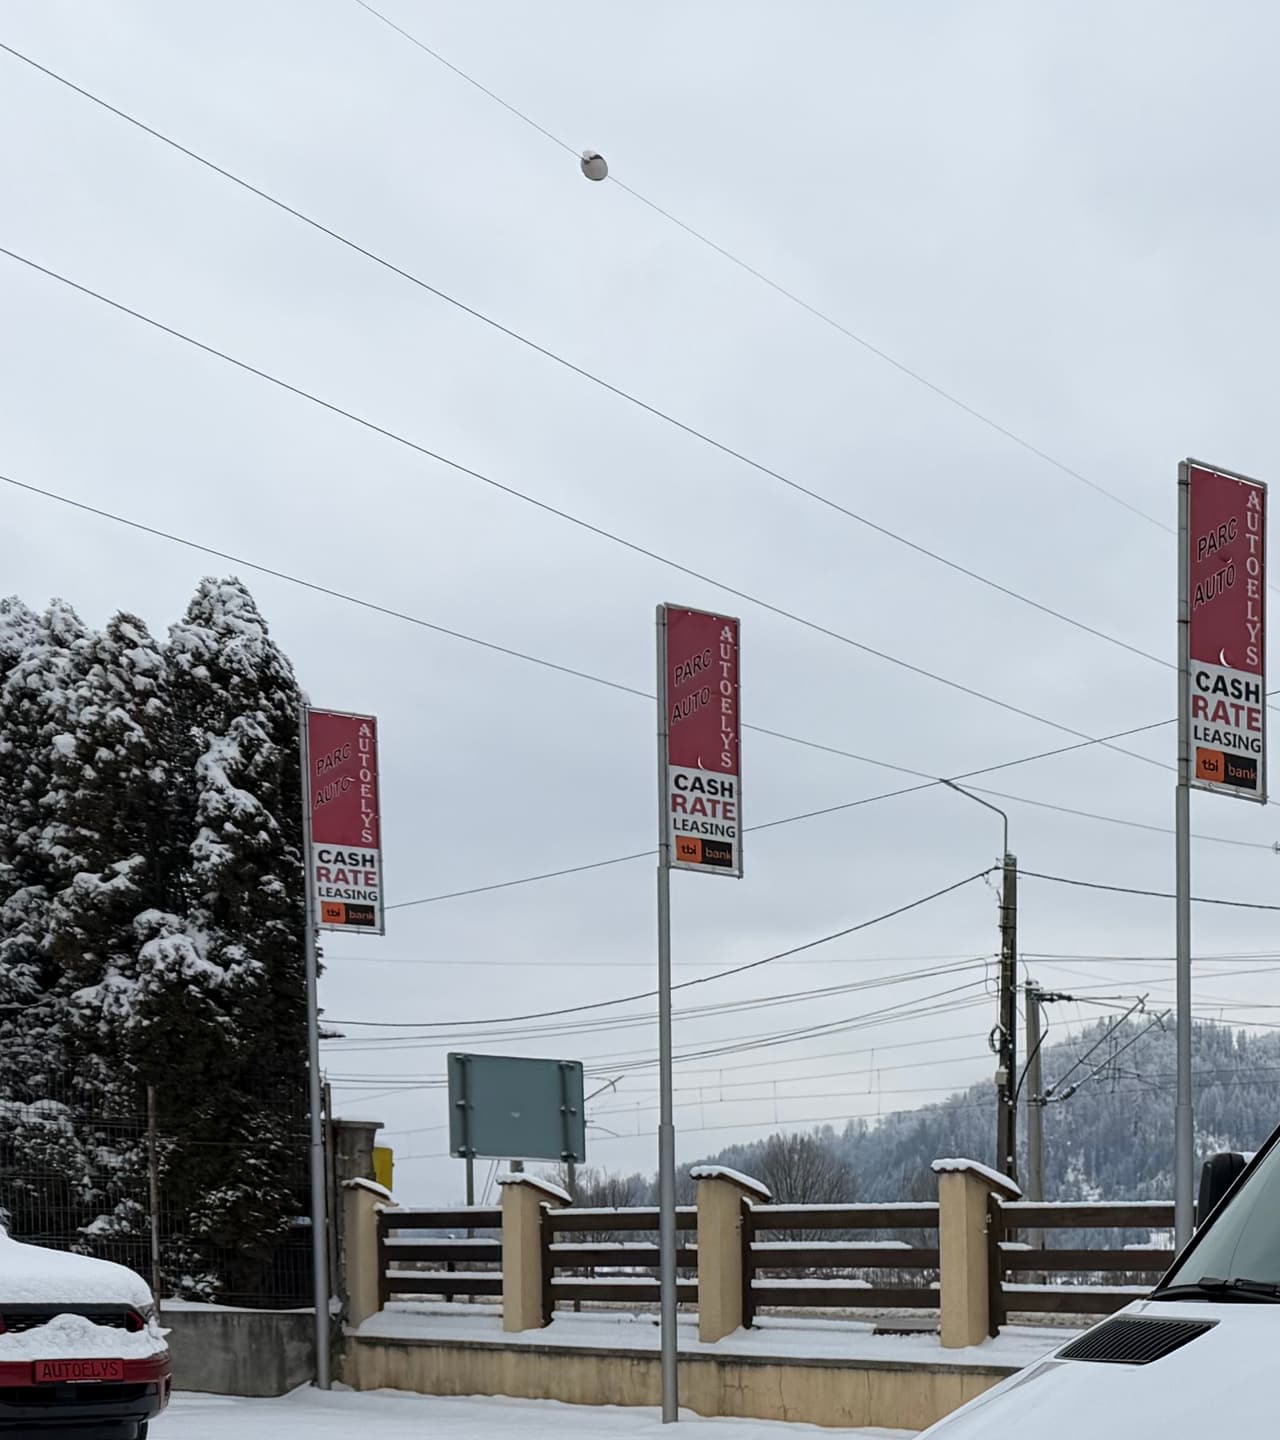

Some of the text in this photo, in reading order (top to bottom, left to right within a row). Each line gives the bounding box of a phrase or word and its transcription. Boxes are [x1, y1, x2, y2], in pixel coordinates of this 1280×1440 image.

[1196, 516, 1239, 563] PARC
[1193, 563, 1236, 610] AUTO
[1245, 490, 1262, 666] AUTOELYS
[673, 648, 712, 688] PARC
[719, 625, 734, 769] AUTOELYS
[1195, 671, 1260, 704] CASH
[671, 686, 712, 726] AUTO
[1192, 694, 1262, 732] RATE
[1194, 725, 1261, 753] LEASING
[316, 743, 351, 776] PARC
[1202, 759, 1219, 772] tbi
[313, 775, 352, 810] AUTO
[358, 723, 374, 843] AUTOELYS
[673, 774, 734, 799] CASH
[671, 793, 736, 822] RATE
[673, 818, 736, 839] LEASING
[318, 849, 375, 868] CASH
[316, 866, 377, 887] RATE
[318, 886, 378, 901] LEASING
[42, 1361, 119, 1378] AUTOELYS
